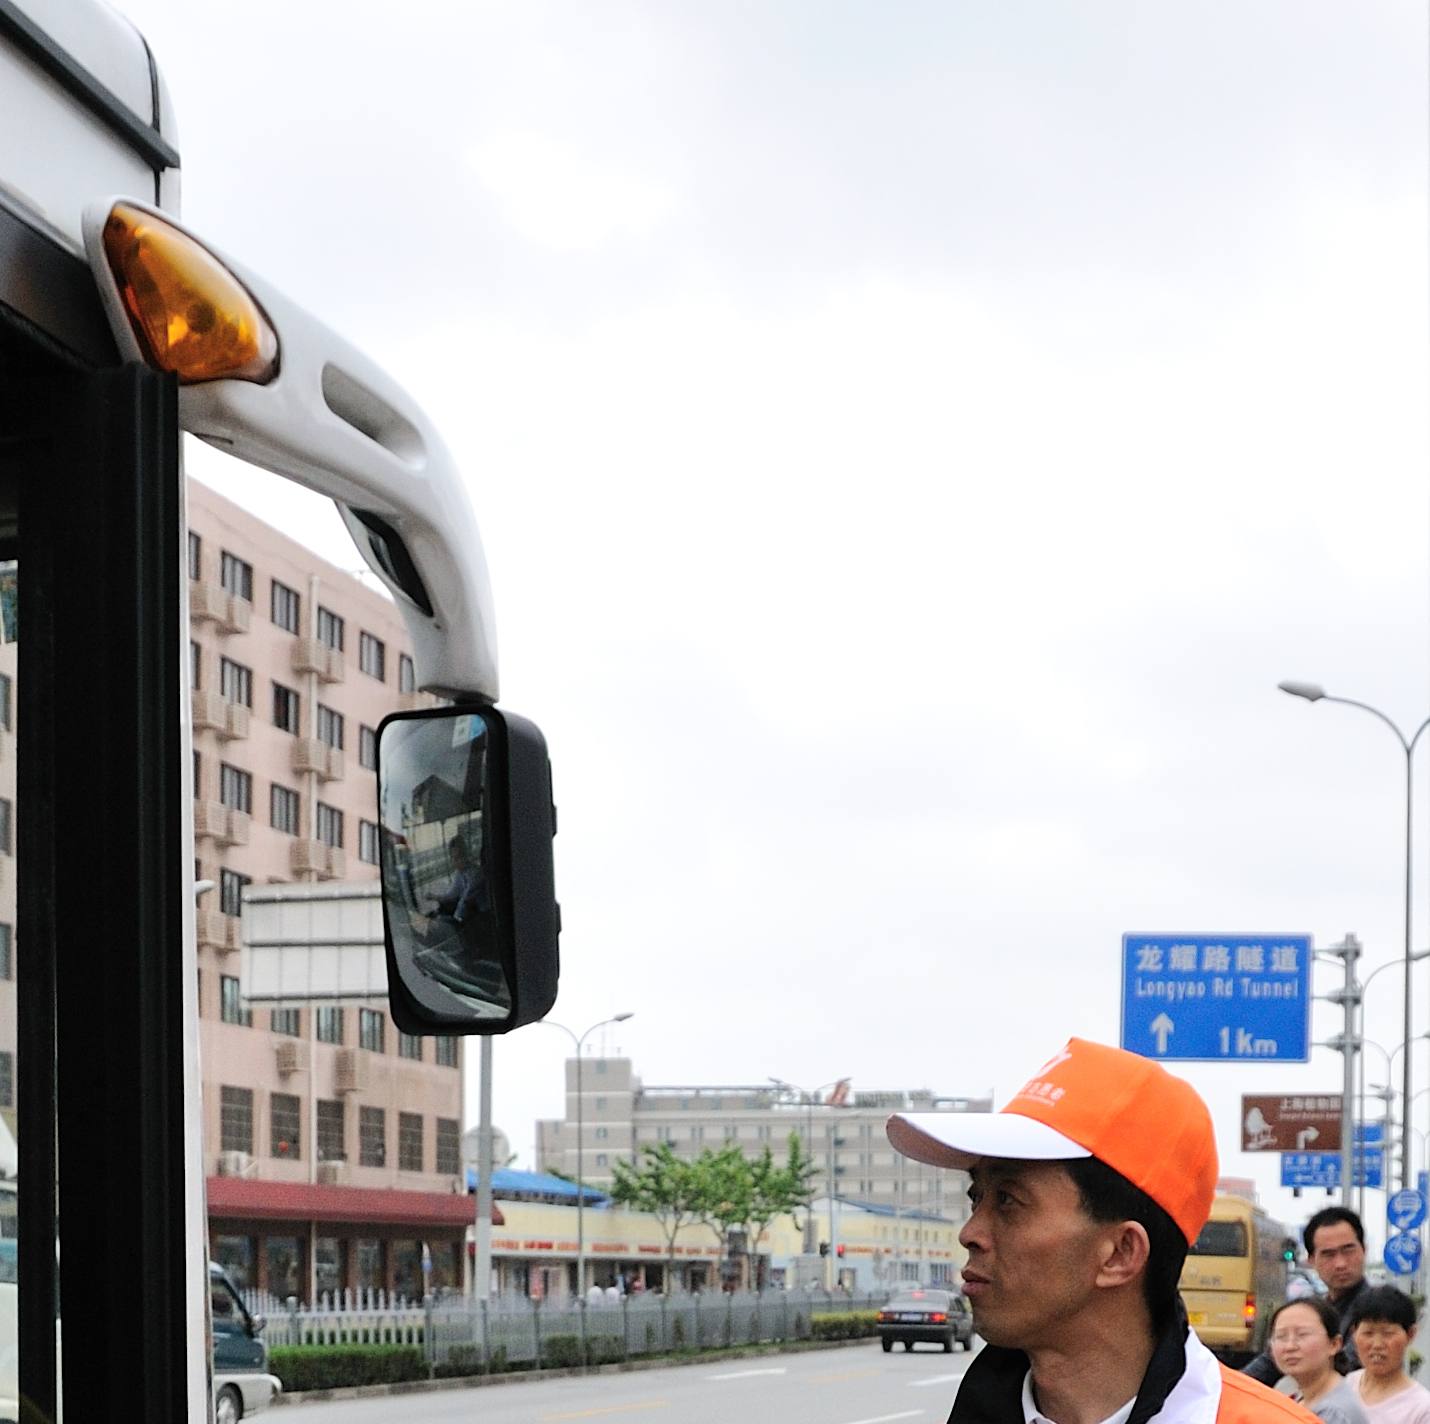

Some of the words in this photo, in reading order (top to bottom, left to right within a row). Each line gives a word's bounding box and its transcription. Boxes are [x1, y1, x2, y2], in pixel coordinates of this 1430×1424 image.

[1136, 944, 1300, 972] 龙耀路隧道
[1136, 977, 1206, 1001] Longyao
[1213, 977, 1234, 997] Rd
[1242, 977, 1299, 999] Tunnel
